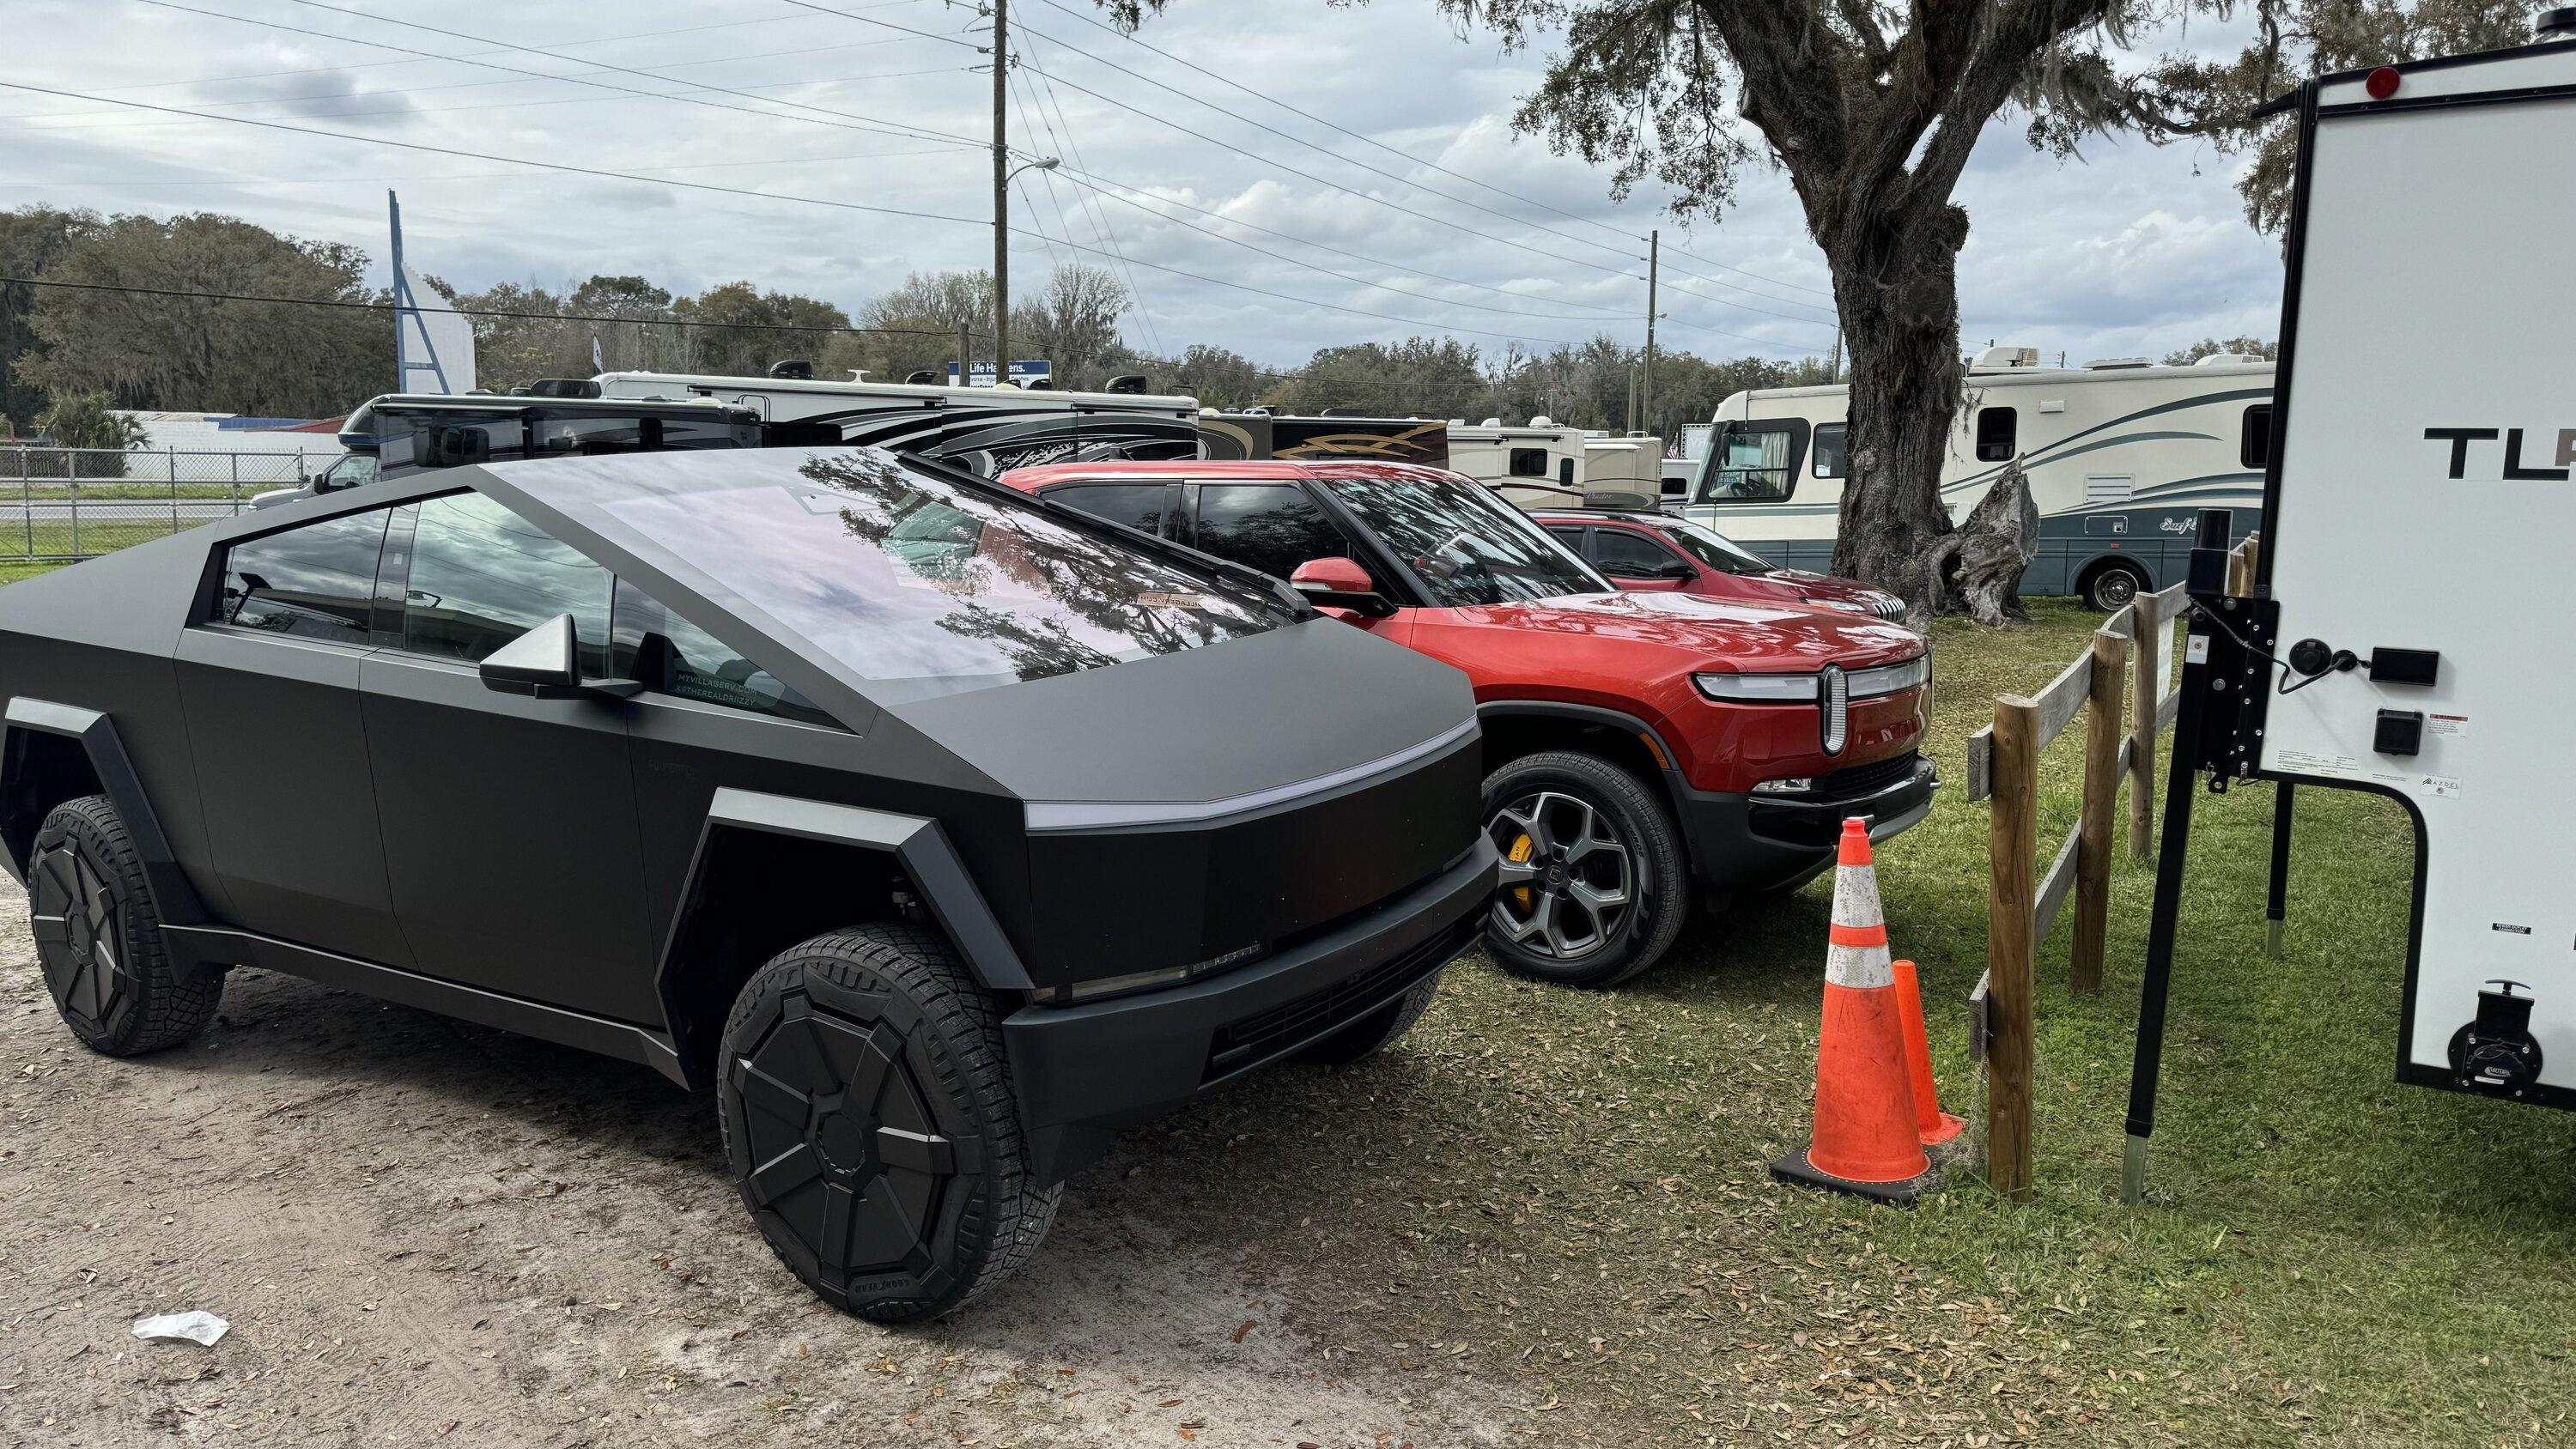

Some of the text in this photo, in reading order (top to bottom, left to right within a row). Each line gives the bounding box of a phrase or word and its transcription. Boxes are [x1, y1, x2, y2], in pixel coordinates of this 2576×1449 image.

[969, 362, 1026, 373] Life Haens.
[2424, 427, 2576, 481] TL
